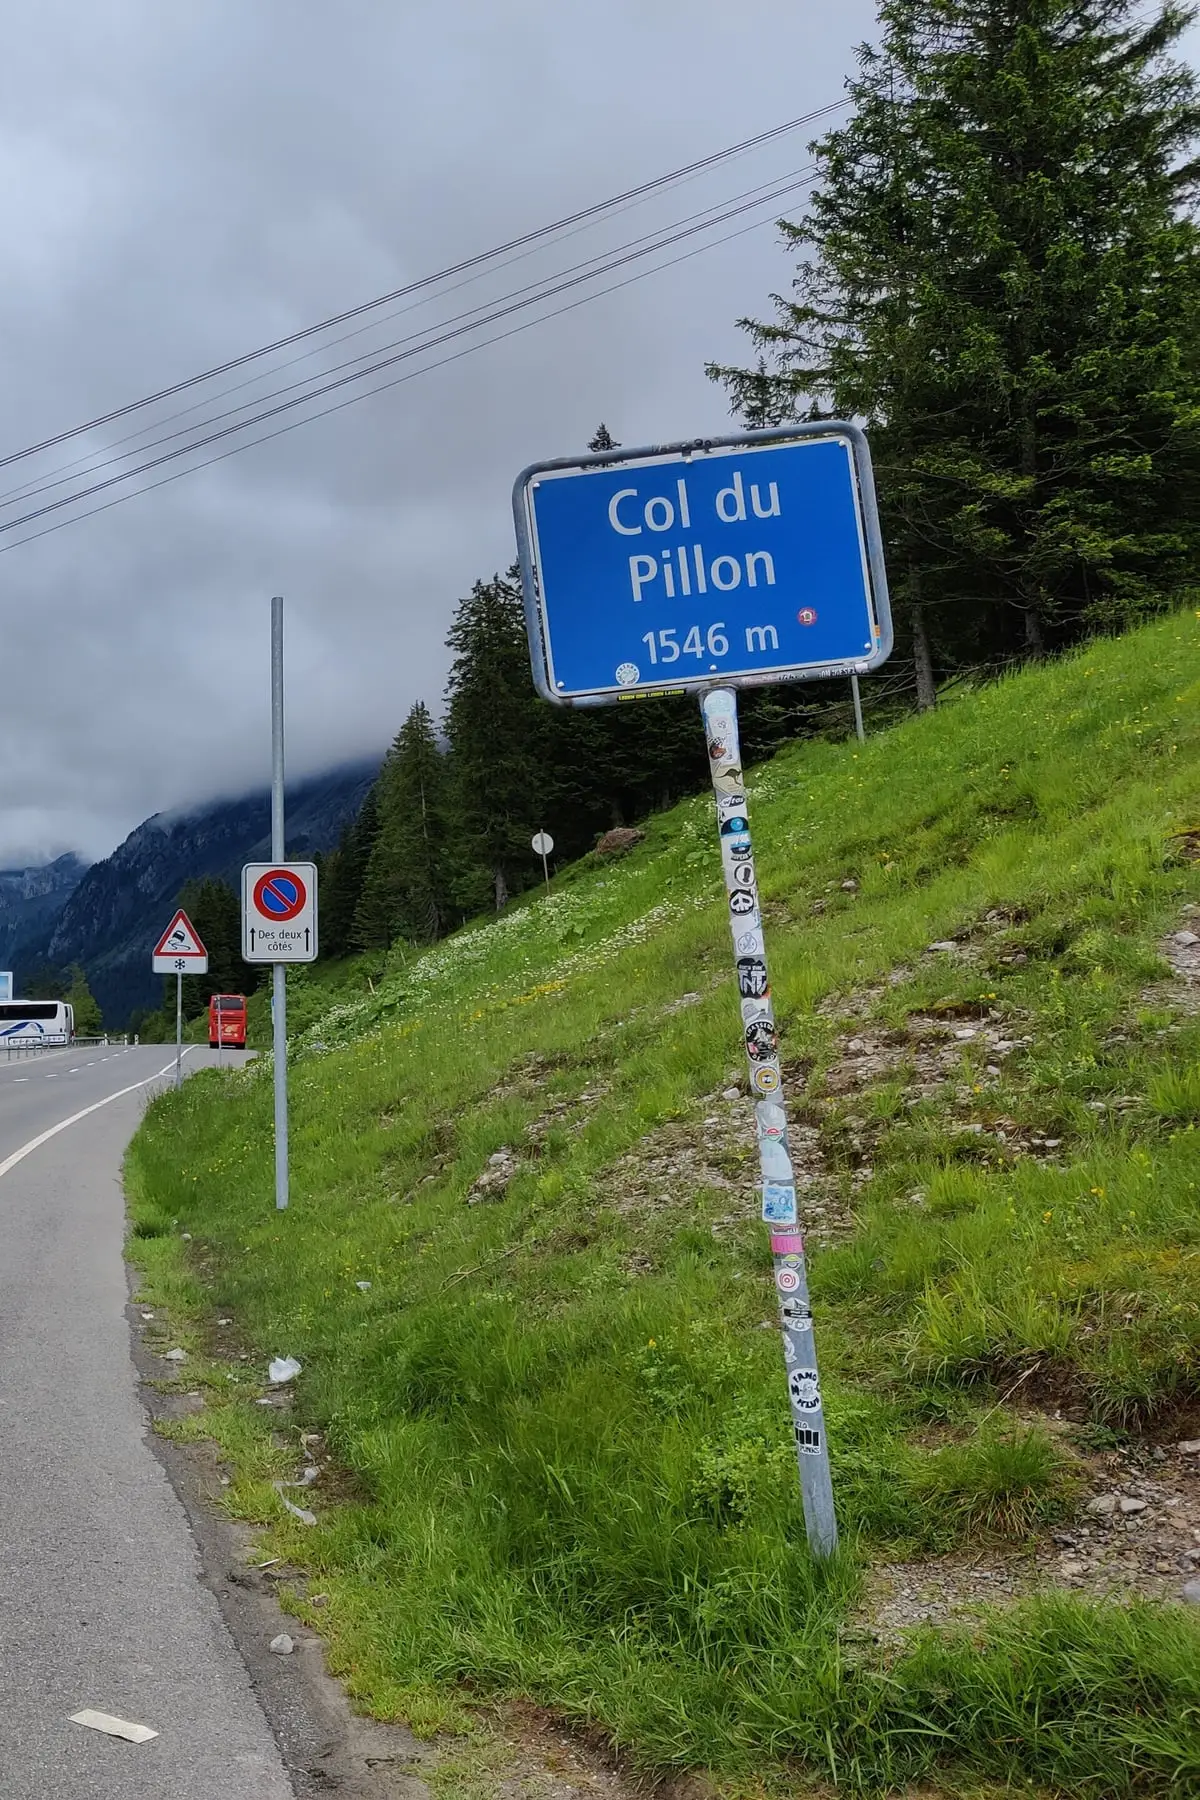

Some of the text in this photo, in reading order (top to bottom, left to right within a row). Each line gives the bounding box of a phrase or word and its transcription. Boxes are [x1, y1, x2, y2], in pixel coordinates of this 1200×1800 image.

[608, 471, 782, 536] Col du
[629, 543, 776, 602] Pillon
[641, 622, 779, 665] 1546 m
[258, 930, 302, 940] Des deux
[267, 941, 293, 951] côtés
